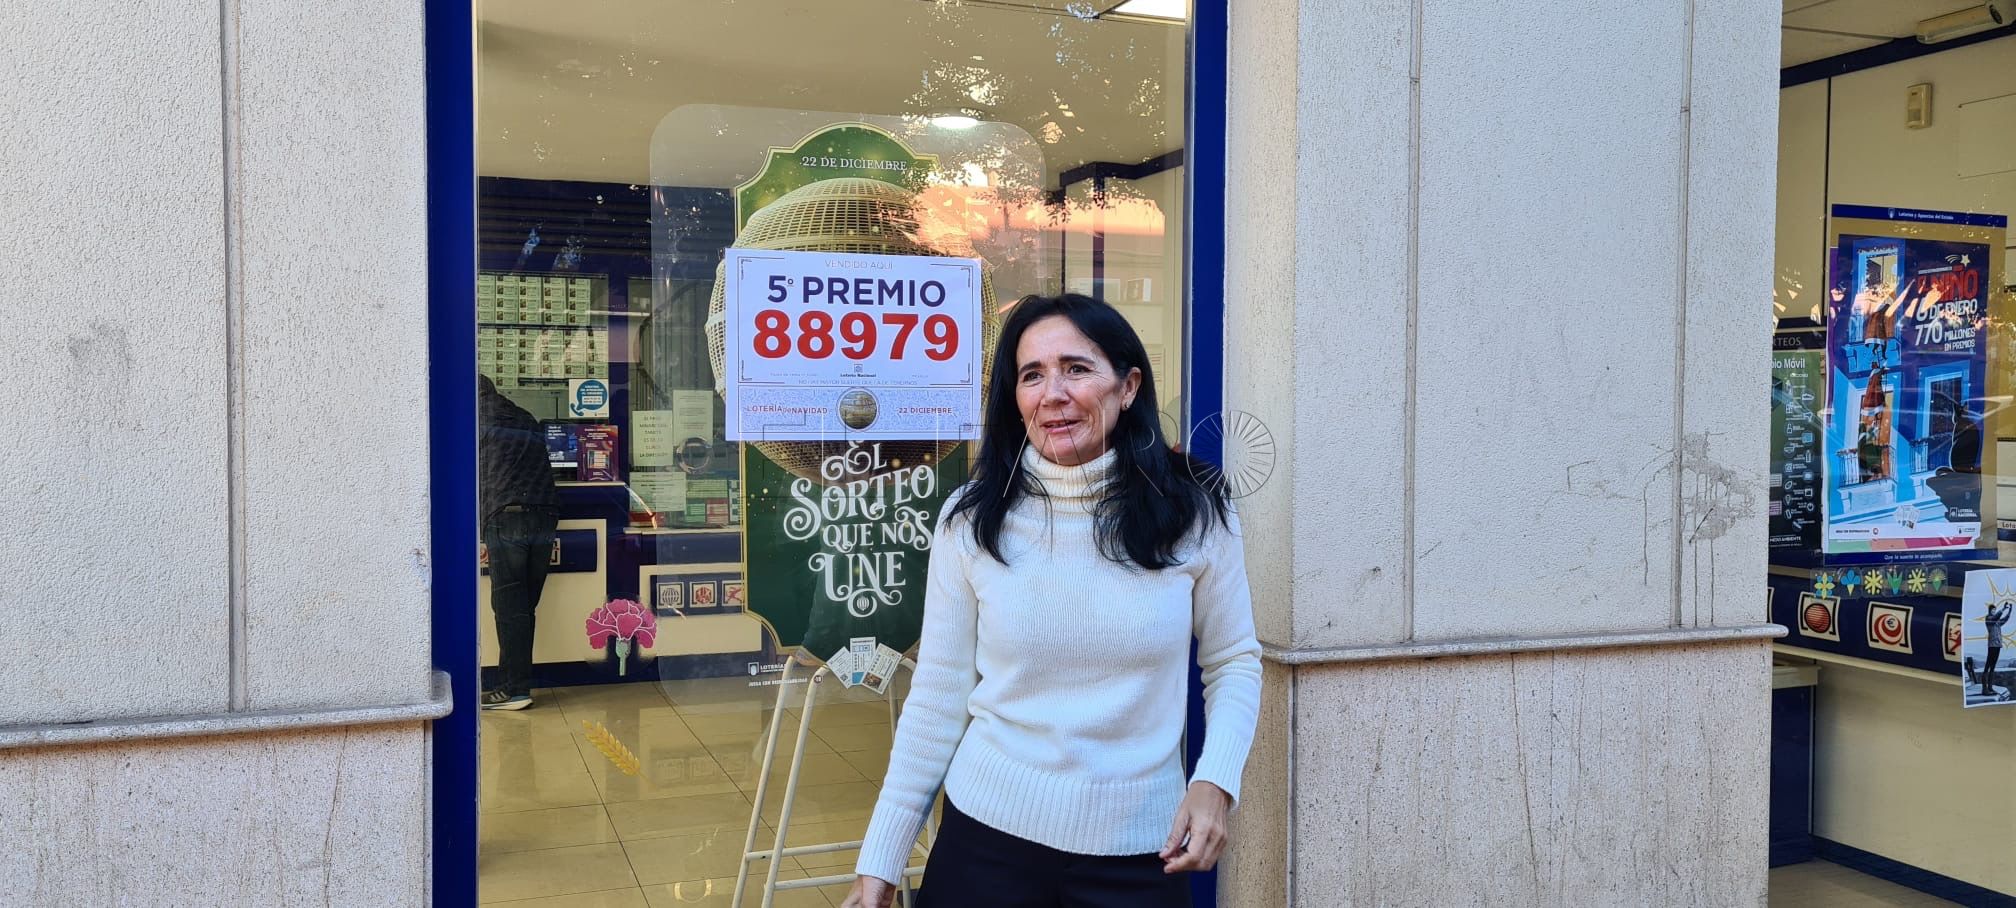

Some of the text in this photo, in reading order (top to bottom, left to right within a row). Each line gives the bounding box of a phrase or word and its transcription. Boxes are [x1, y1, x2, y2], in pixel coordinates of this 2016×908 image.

[802, 156, 908, 170] 22 DE DICIEMBRE
[825, 259, 867, 269] VENDIDO
[803, 276, 946, 307] PREMIO
[1944, 298, 1978, 317] ENERO
[753, 309, 959, 361] 88979
[1914, 318, 1943, 347] 770
[1944, 327, 1976, 341] MILLONES
[1952, 339, 1975, 351] PREMIOS
[1783, 357, 1806, 369] Móvil
[783, 465, 935, 541] SORTEO
[823, 506, 934, 553] QUE NOS
[808, 551, 907, 618] UNE
